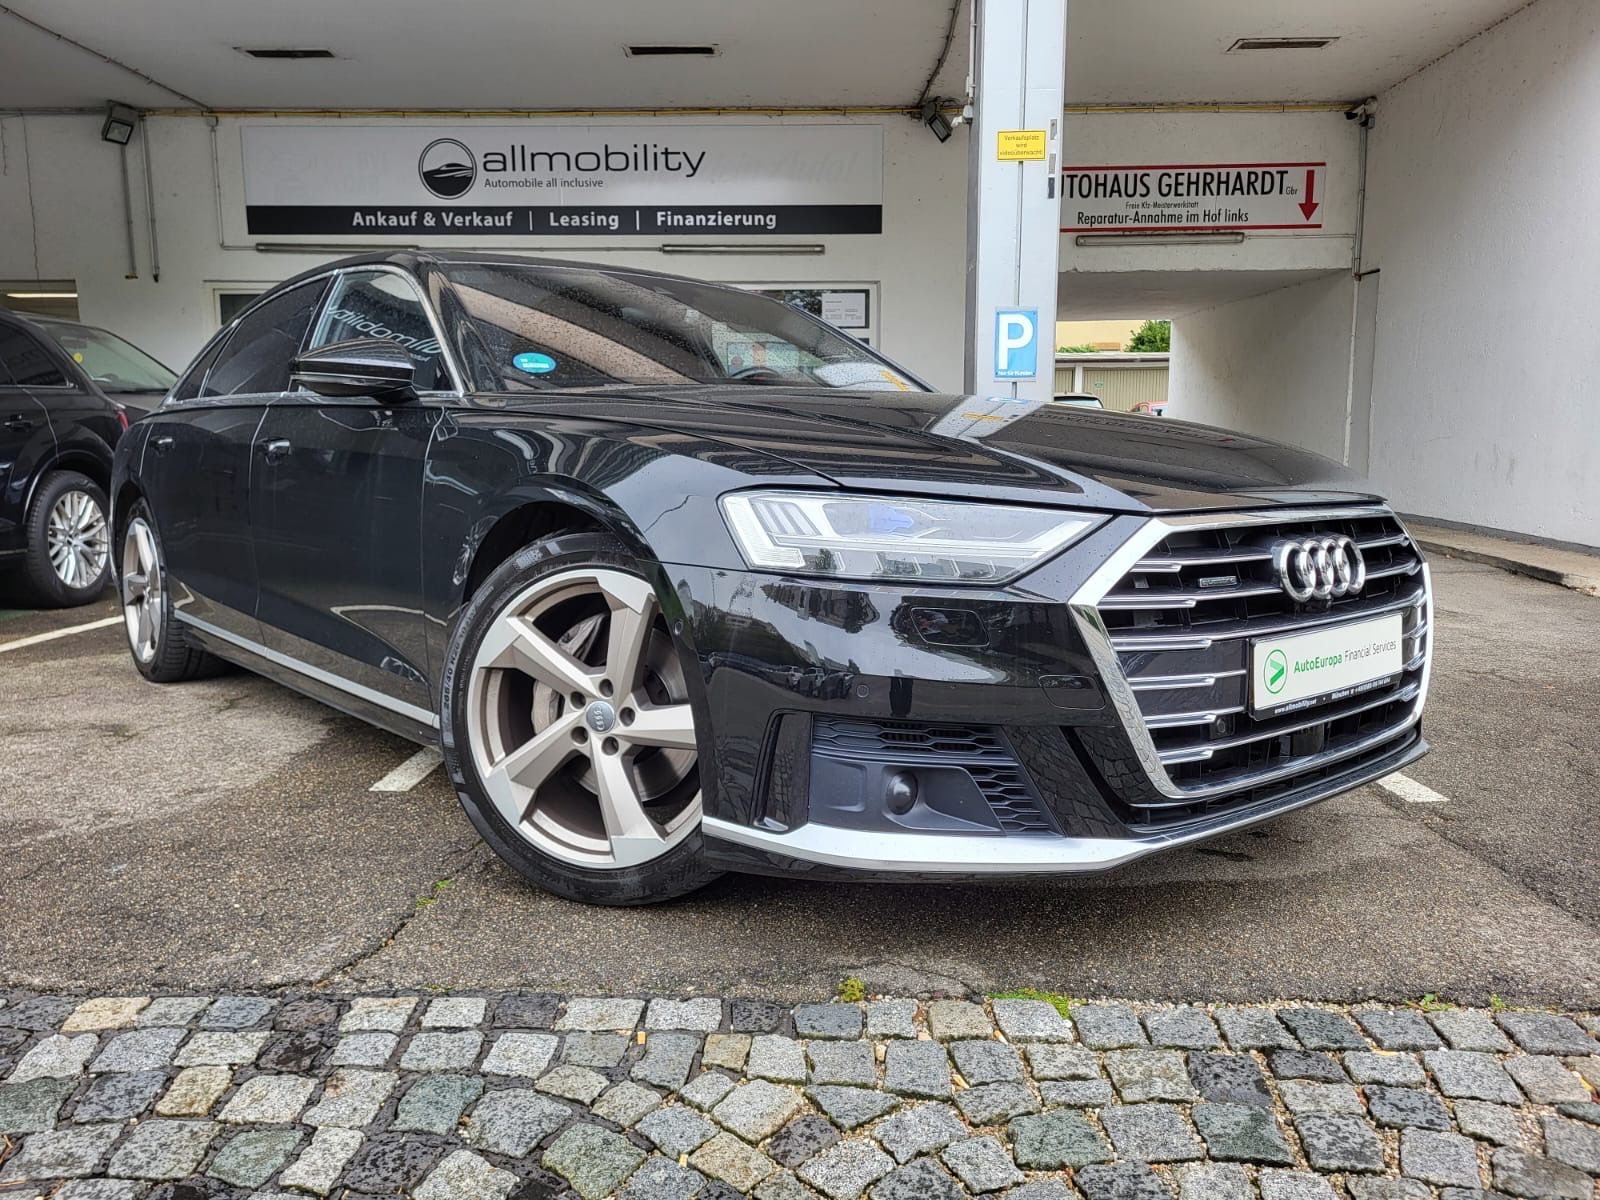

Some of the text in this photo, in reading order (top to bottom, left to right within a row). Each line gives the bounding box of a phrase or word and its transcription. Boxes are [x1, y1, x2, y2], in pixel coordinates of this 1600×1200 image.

[483, 144, 706, 178] allmobility
[484, 178, 604, 188] Automobile all inclusive
[1157, 170, 1289, 197] GEHRHARDT
[1125, 201, 1199, 209] Freie Kfz-Meisterwerkstatt
[352, 210, 777, 230] Ankauf & Verkauf Leasing Finanzierung
[1077, 208, 1249, 227] Reparatur-Annahme im Hof links
[998, 313, 1034, 370] P
[1294, 640, 1397, 674] AutoEuropa Financial Services
